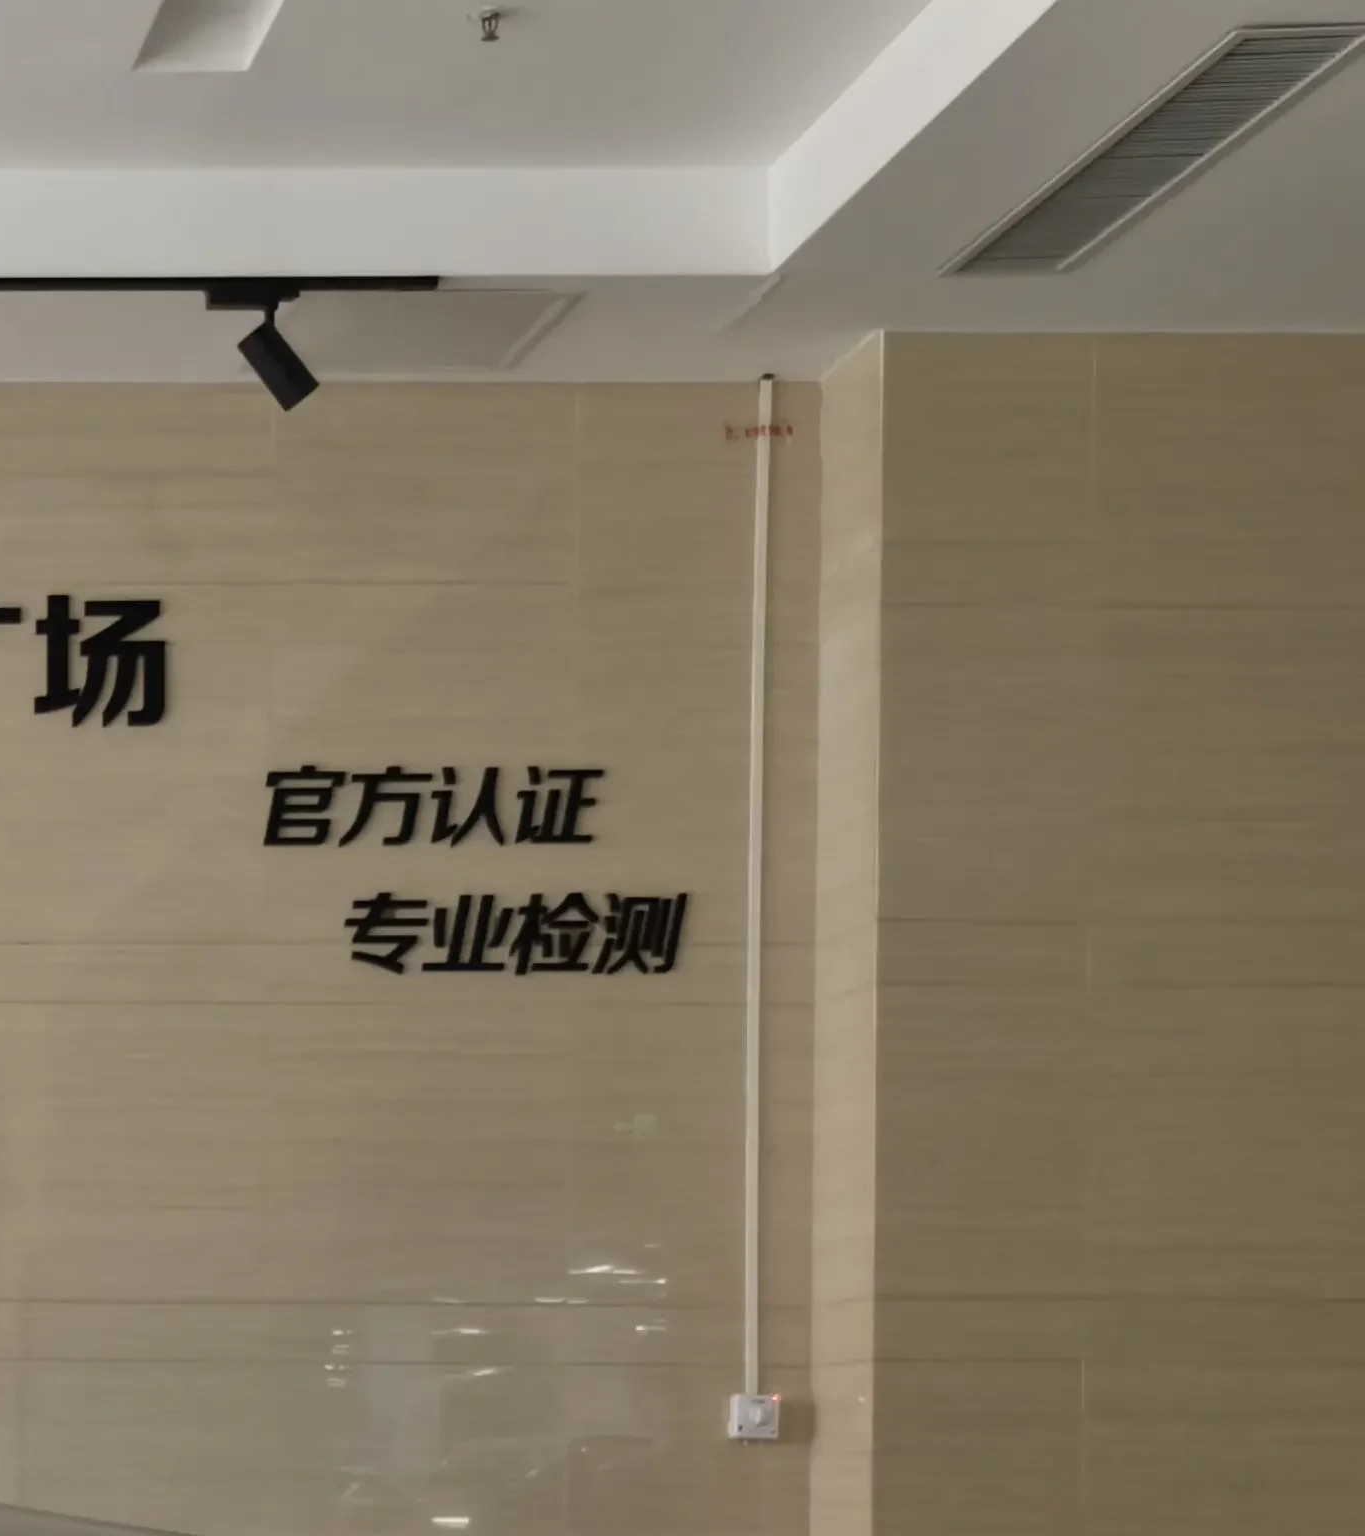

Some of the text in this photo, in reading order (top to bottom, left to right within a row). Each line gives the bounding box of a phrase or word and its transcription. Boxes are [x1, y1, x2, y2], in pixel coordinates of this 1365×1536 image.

[263, 764, 606, 848] 官方认证
[344, 891, 689, 976] 专业检测
